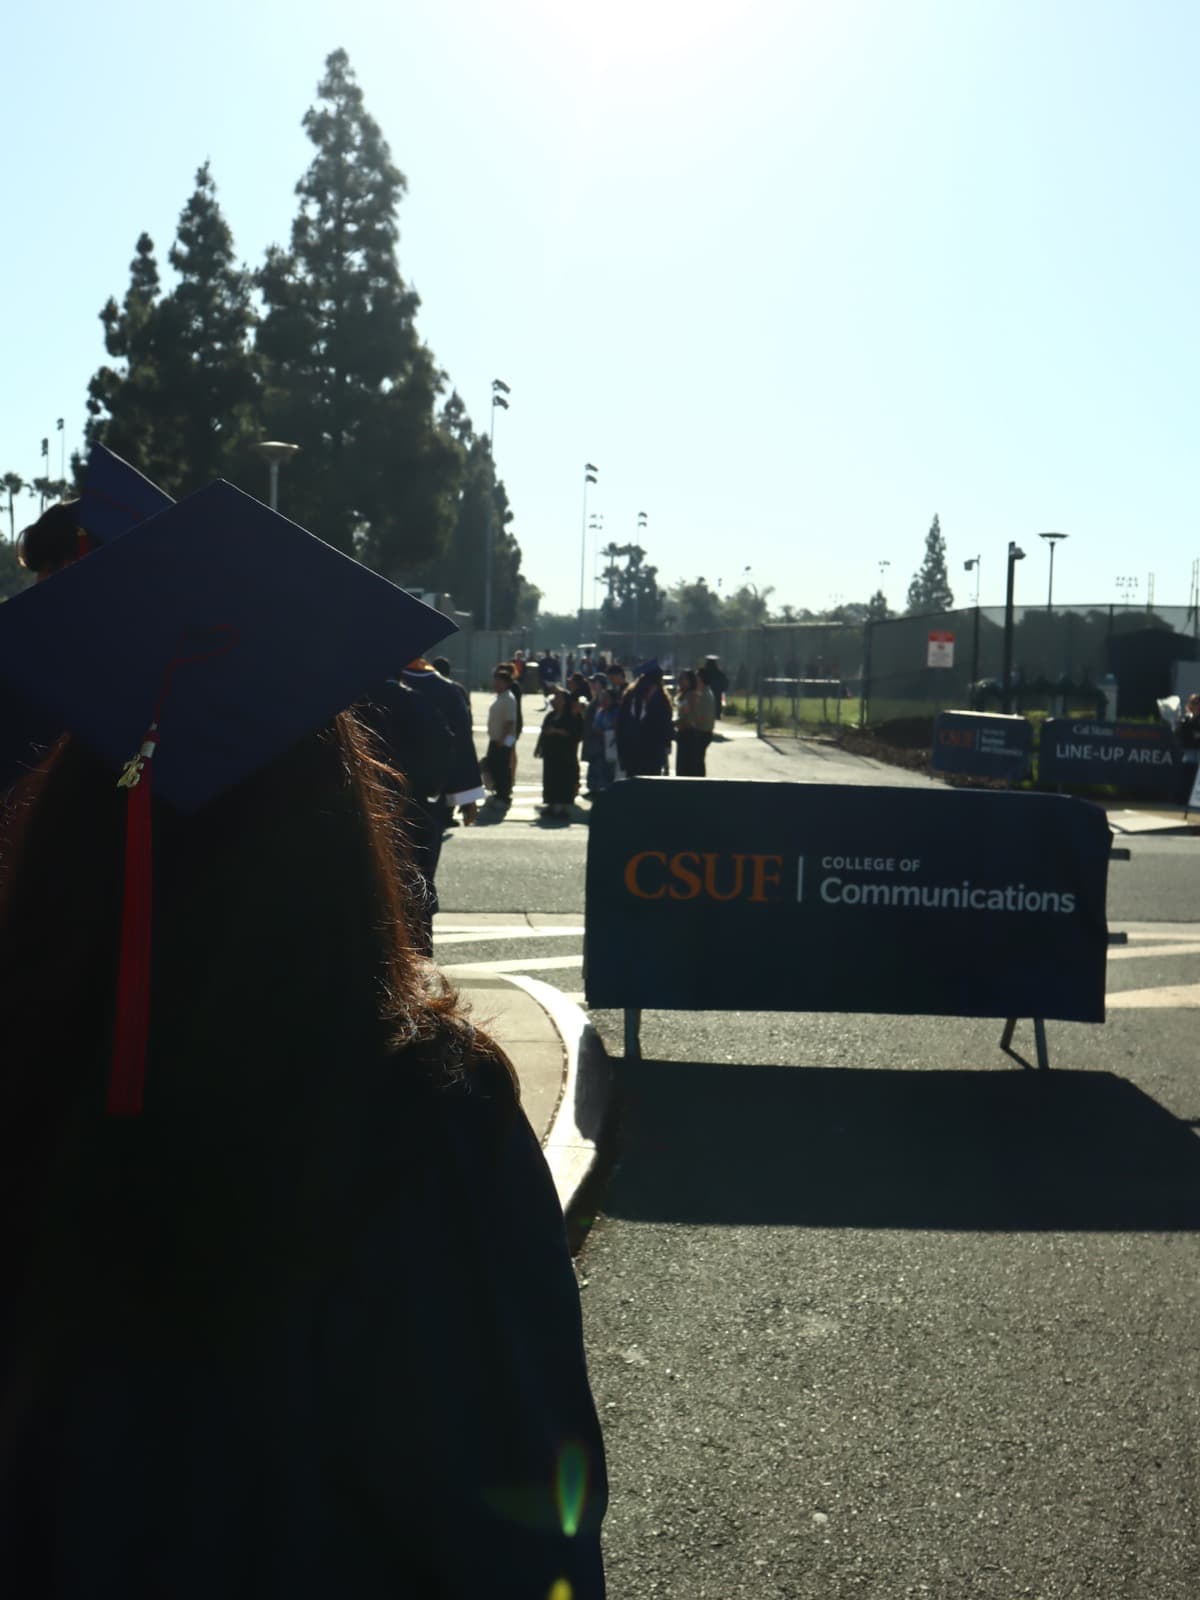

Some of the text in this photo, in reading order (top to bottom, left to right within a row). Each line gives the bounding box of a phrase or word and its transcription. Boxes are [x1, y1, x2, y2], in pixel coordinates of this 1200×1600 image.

[1055, 743, 1173, 766] LINE-UP AREA
[623, 850, 784, 903] CSUF
[821, 855, 922, 873] COLLEGE OF
[819, 876, 1076, 914] Communications
